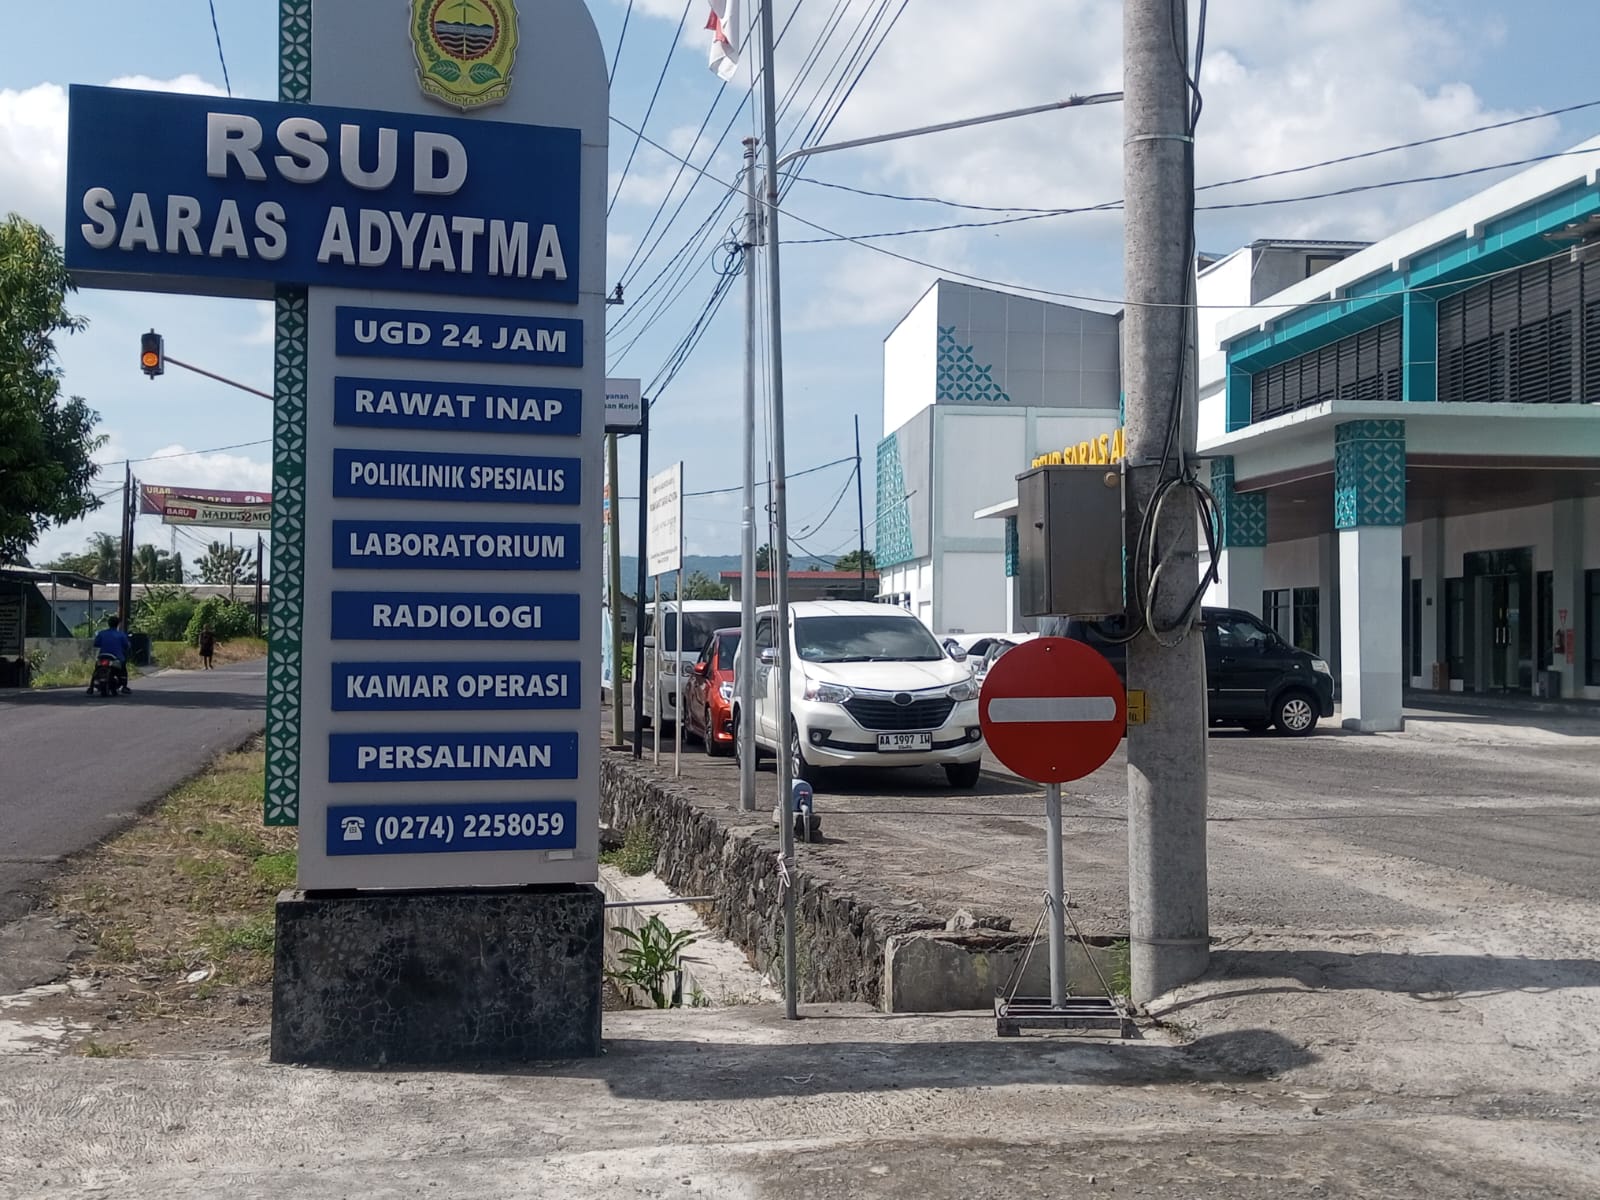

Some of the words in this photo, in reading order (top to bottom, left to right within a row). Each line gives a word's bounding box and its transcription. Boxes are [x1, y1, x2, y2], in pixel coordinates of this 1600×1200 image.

[205, 112, 468, 196] RSUD
[81, 187, 287, 261] SARAS
[317, 206, 568, 281] ADYATMA
[354, 319, 431, 345] UGD
[441, 324, 483, 348] 24
[492, 327, 566, 353] JAM
[355, 389, 476, 418] RAWAT
[485, 396, 563, 422] INAP
[618, 402, 639, 411] Kerja
[351, 461, 465, 489] POLIKLINIK
[470, 466, 565, 492] SPESIALIS
[166, 507, 190, 516] BARU
[350, 532, 565, 558] LABORATORIUM
[373, 604, 542, 629] RADIOLOGI
[347, 674, 449, 698] KAMAR
[457, 674, 568, 698] OPERASI
[880, 735, 890, 745] AA
[894, 734, 915, 745] 1997
[358, 745, 551, 769] PERSALINAN
[375, 815, 454, 845] (0274)
[463, 813, 565, 838] 2258059
